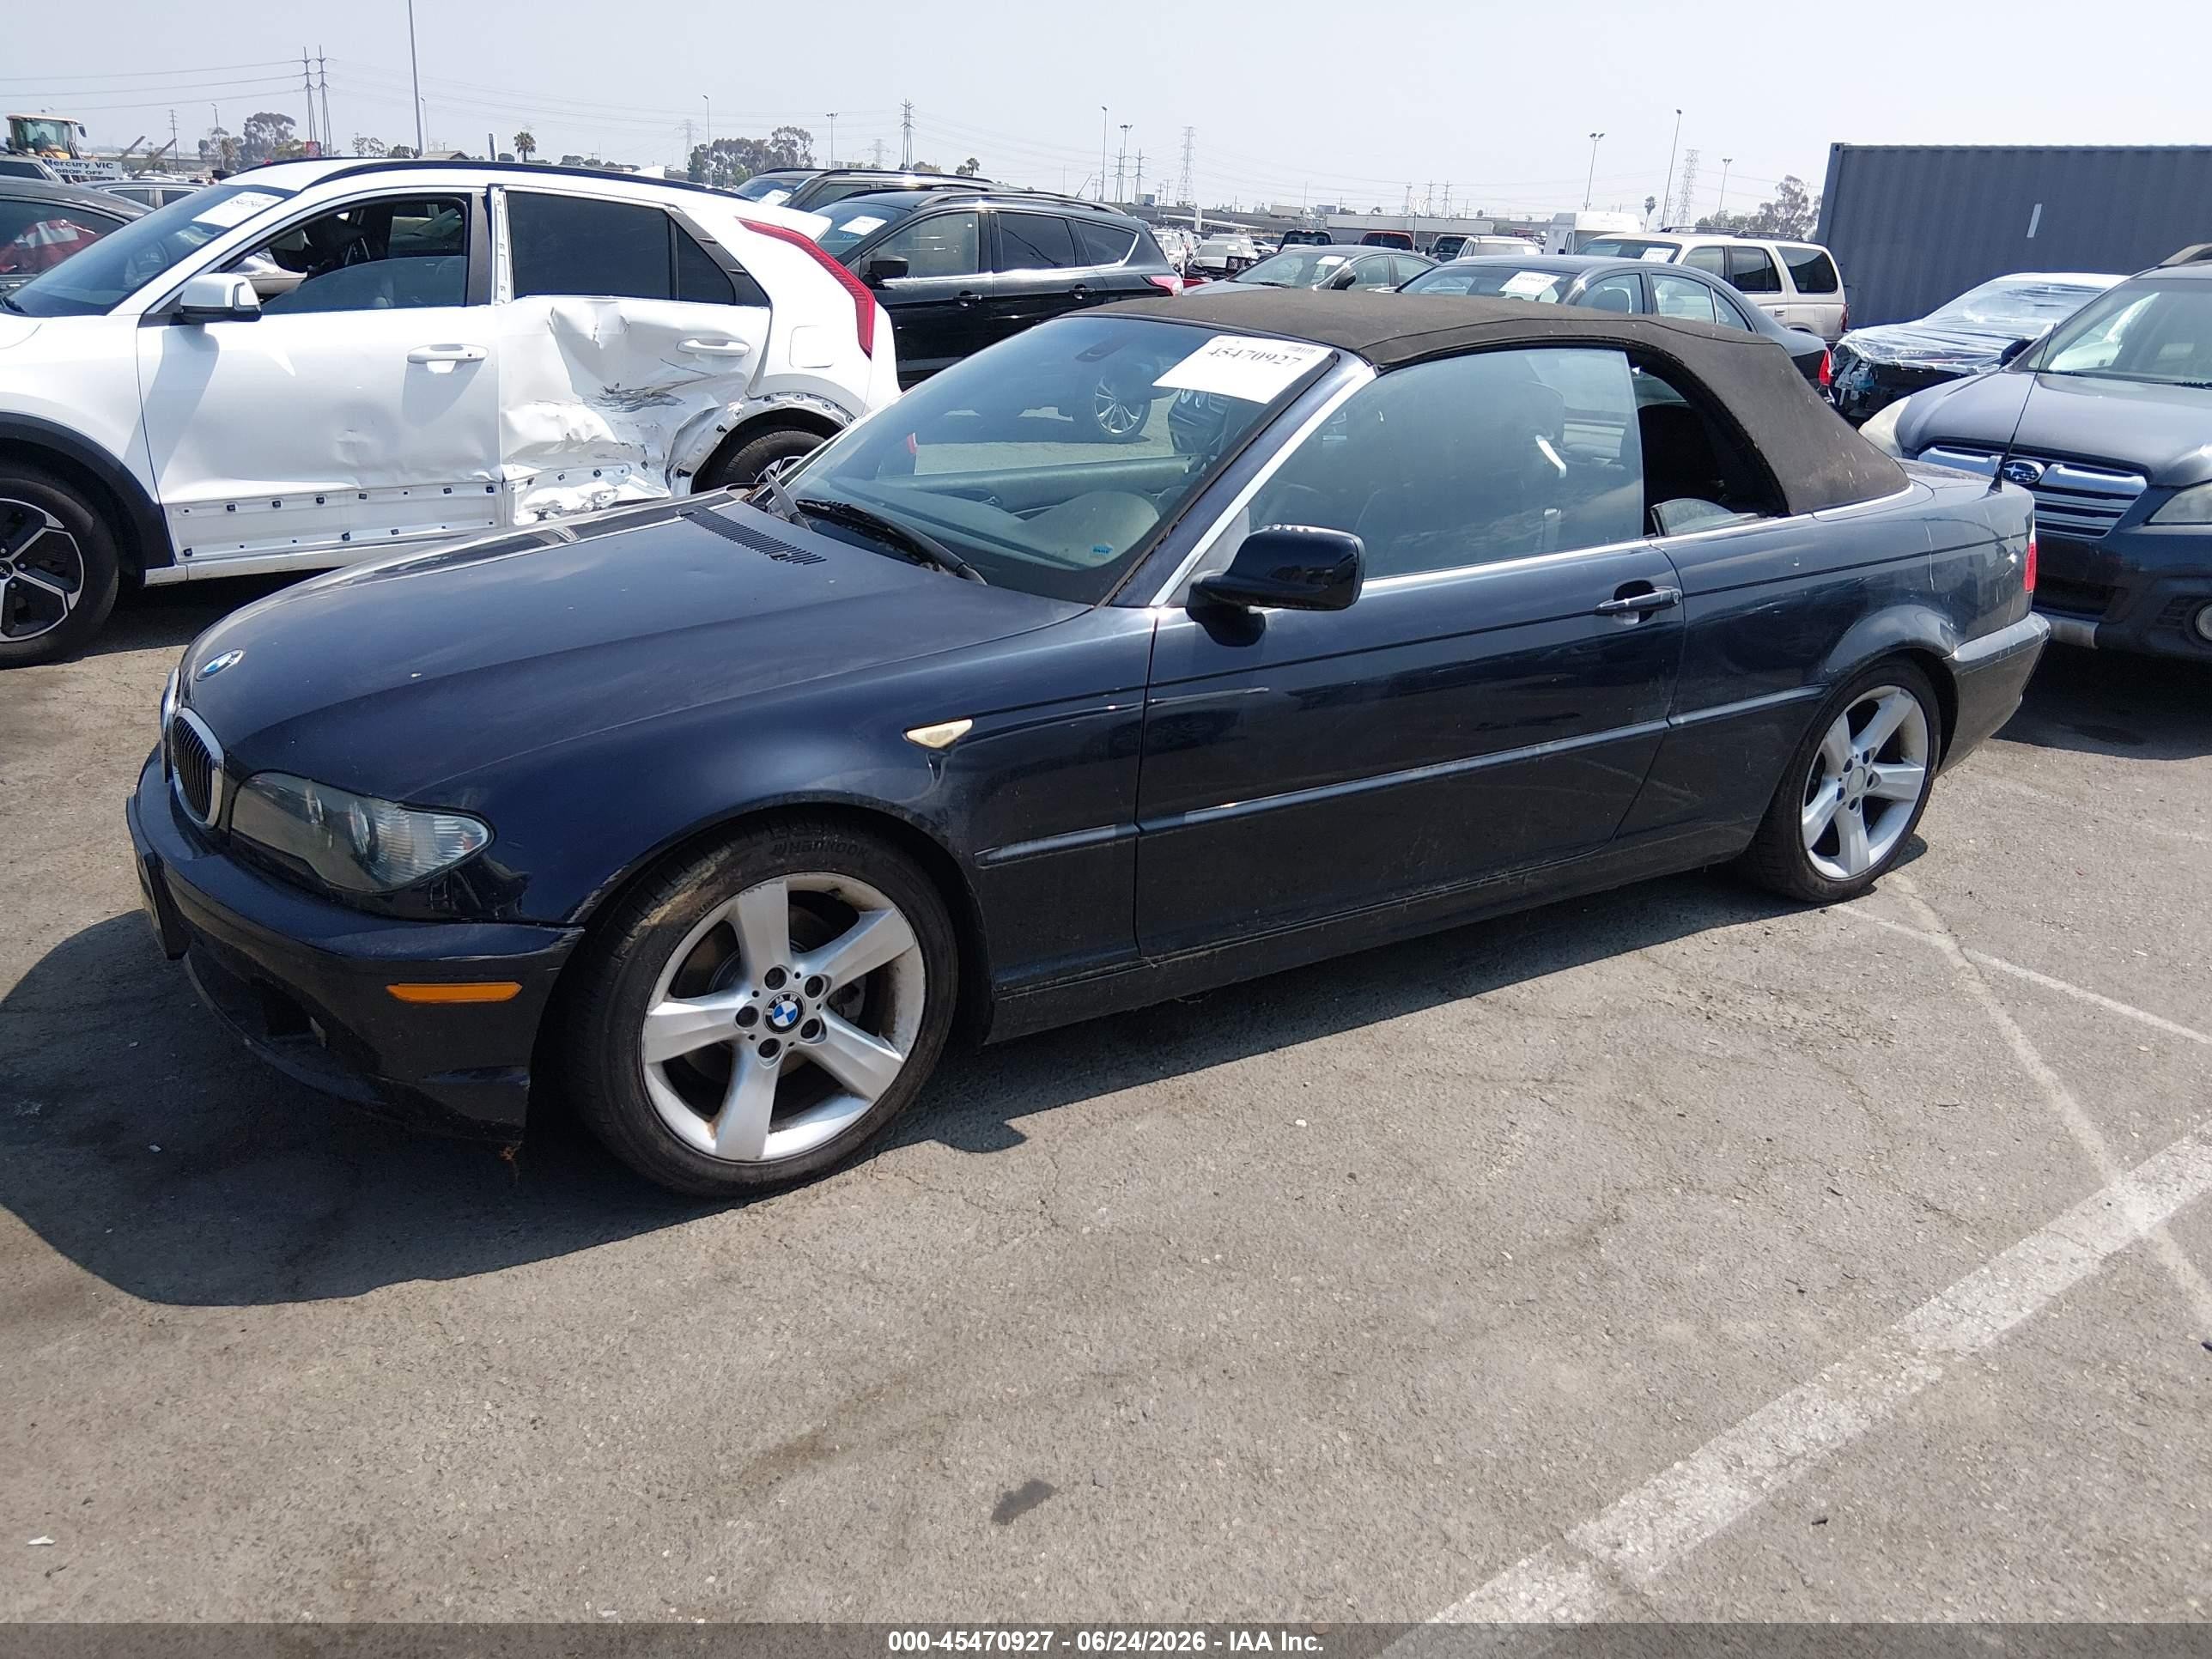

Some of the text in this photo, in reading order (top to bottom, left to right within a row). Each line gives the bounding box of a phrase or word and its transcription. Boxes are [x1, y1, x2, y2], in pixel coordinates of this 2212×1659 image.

[43, 159, 90, 168] Mercury
[1207, 348, 1303, 367] 45470927
[764, 993, 799, 1016] BMW
